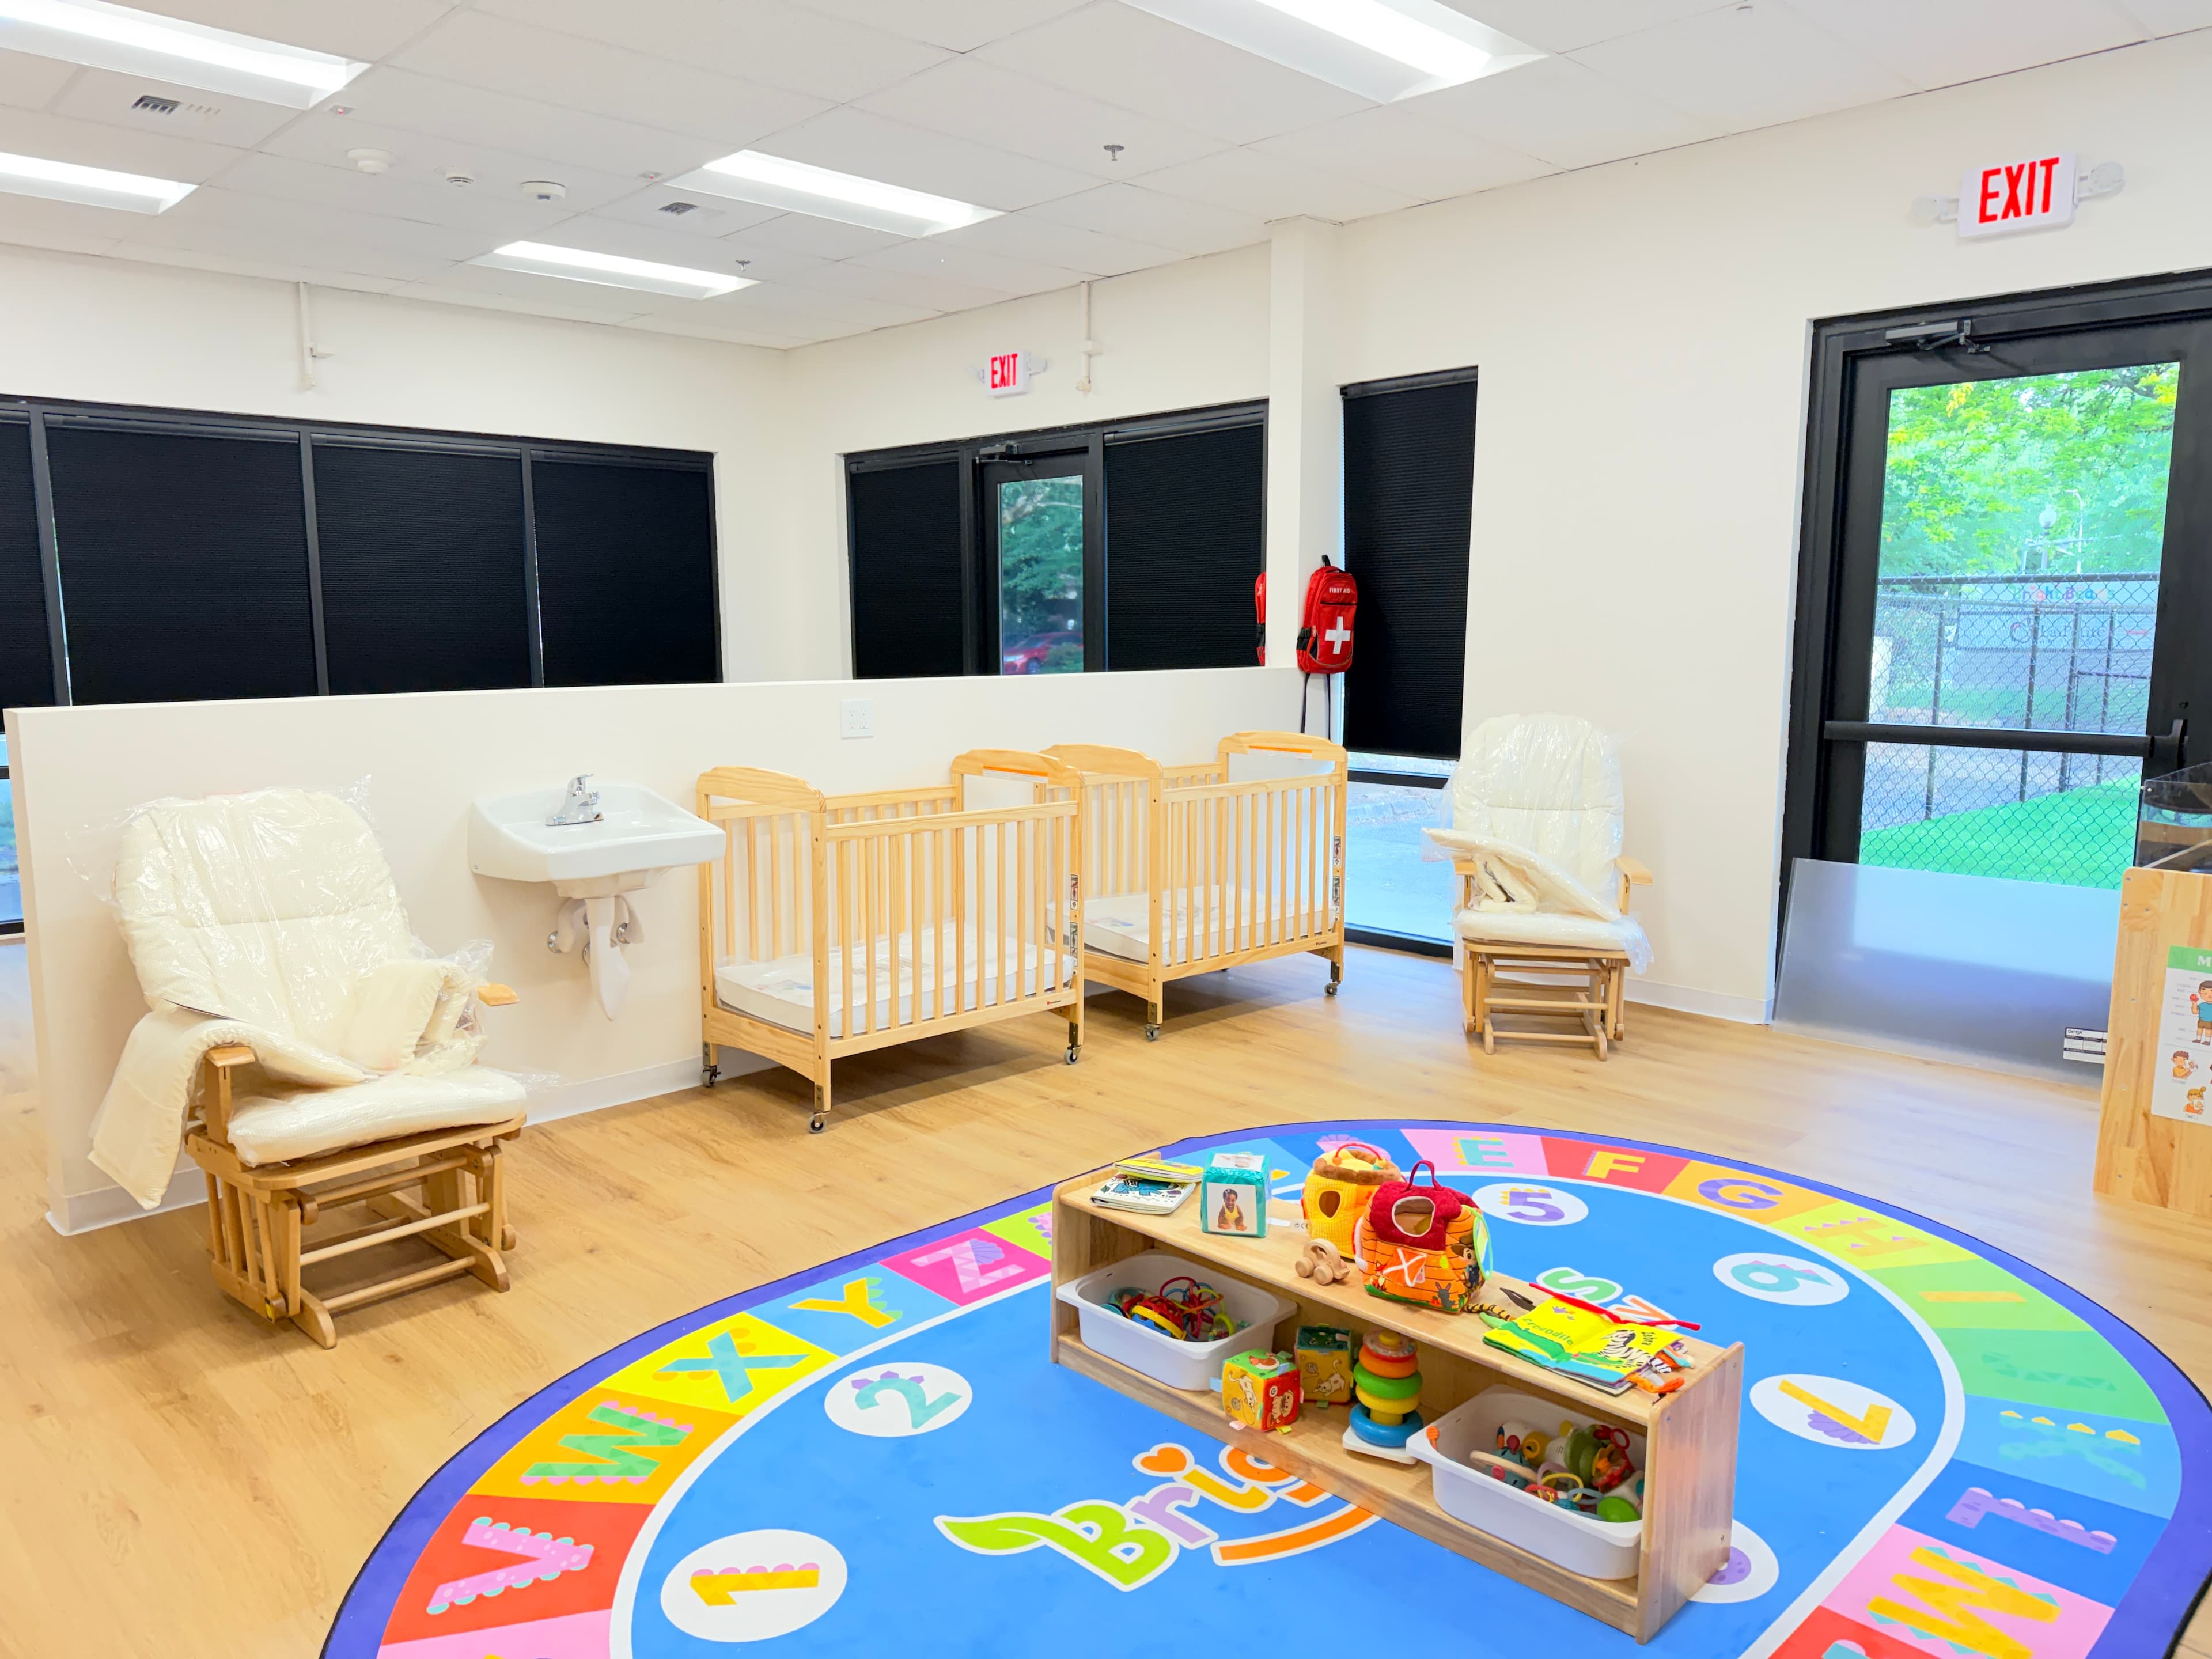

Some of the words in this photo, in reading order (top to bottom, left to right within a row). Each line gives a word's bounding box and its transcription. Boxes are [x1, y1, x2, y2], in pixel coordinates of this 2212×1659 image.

[1978, 157, 2060, 224] EXIT
[991, 353, 1018, 389] EXIT
[2198, 955, 2212, 968] M
[1453, 1136, 1514, 1168] E
[1582, 1150, 1645, 1179] F
[1500, 1187, 1566, 1222] 5
[1698, 1179, 1784, 1210] G
[1803, 1217, 1930, 1257] H
[910, 1238, 1027, 1294] Z
[1730, 1260, 1833, 1293] 6
[788, 1277, 903, 1328] Y
[1918, 1291, 2028, 1302] I
[656, 1331, 810, 1404] X
[851, 1370, 963, 1429] 2
[1778, 1379, 1893, 1445] 7
[520, 1401, 694, 1486] W
[1999, 1410, 2146, 1491] K
[941, 1444, 1377, 1586] Brig
[1945, 1487, 2118, 1555] L
[427, 1517, 594, 1614] V
[690, 1563, 820, 1607] 1
[1866, 1546, 2062, 1659] M
